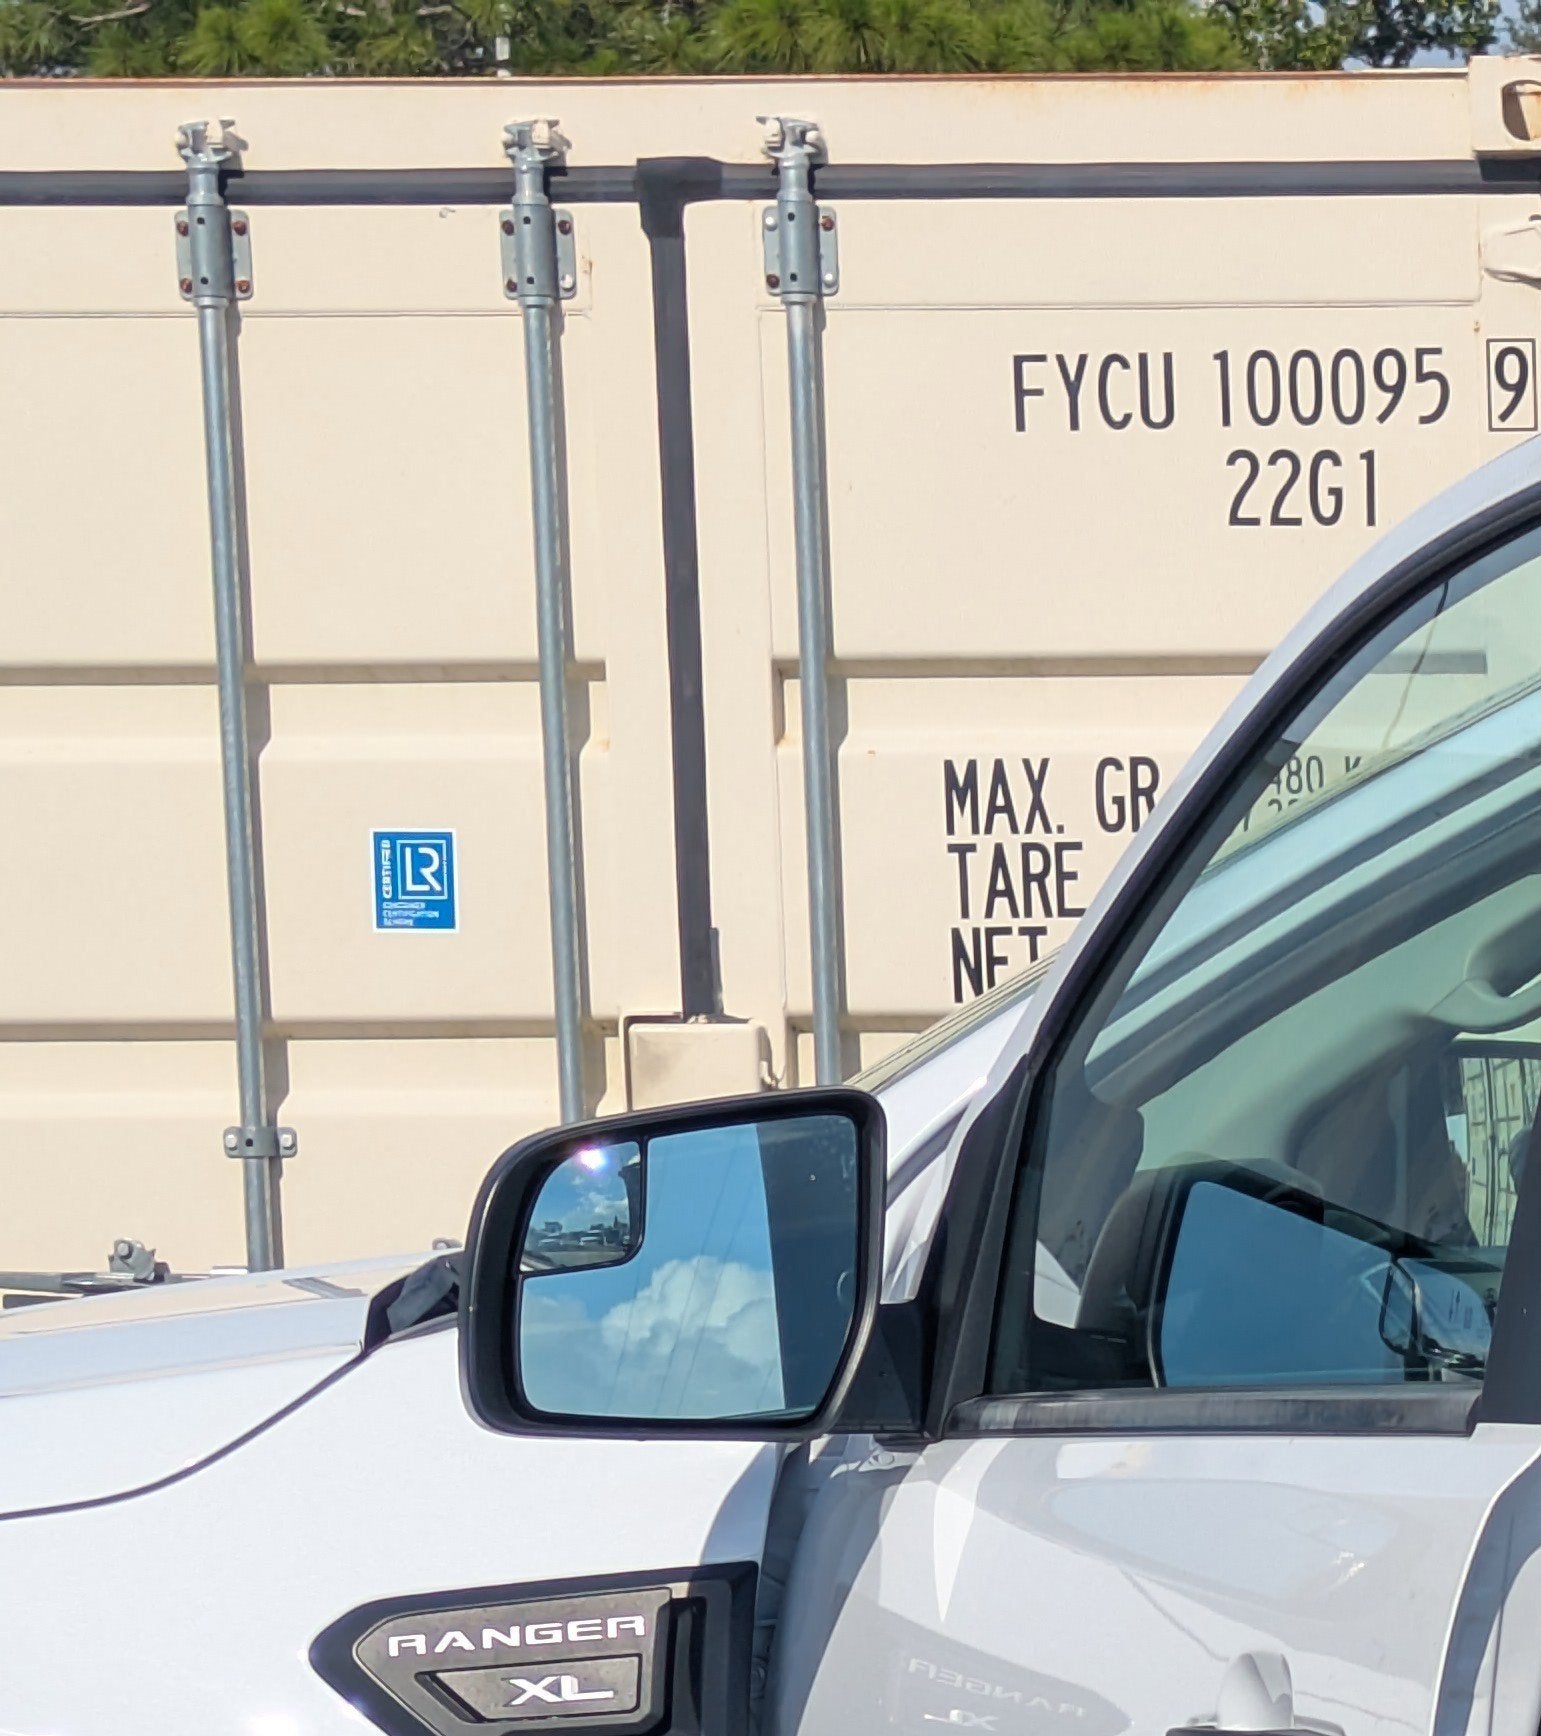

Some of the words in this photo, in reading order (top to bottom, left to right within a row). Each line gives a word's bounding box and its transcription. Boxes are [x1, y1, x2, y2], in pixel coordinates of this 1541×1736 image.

[1013, 352, 1176, 432] FYCU
[1212, 347, 1452, 427] 100095
[1493, 348, 1529, 424] 9
[1226, 448, 1377, 528] 22G1
[943, 757, 1065, 836] MAX.
[405, 846, 442, 891] LR
[947, 841, 1087, 919] TARE
[388, 1615, 647, 1657] RANGER
[509, 1670, 615, 1706] XL
